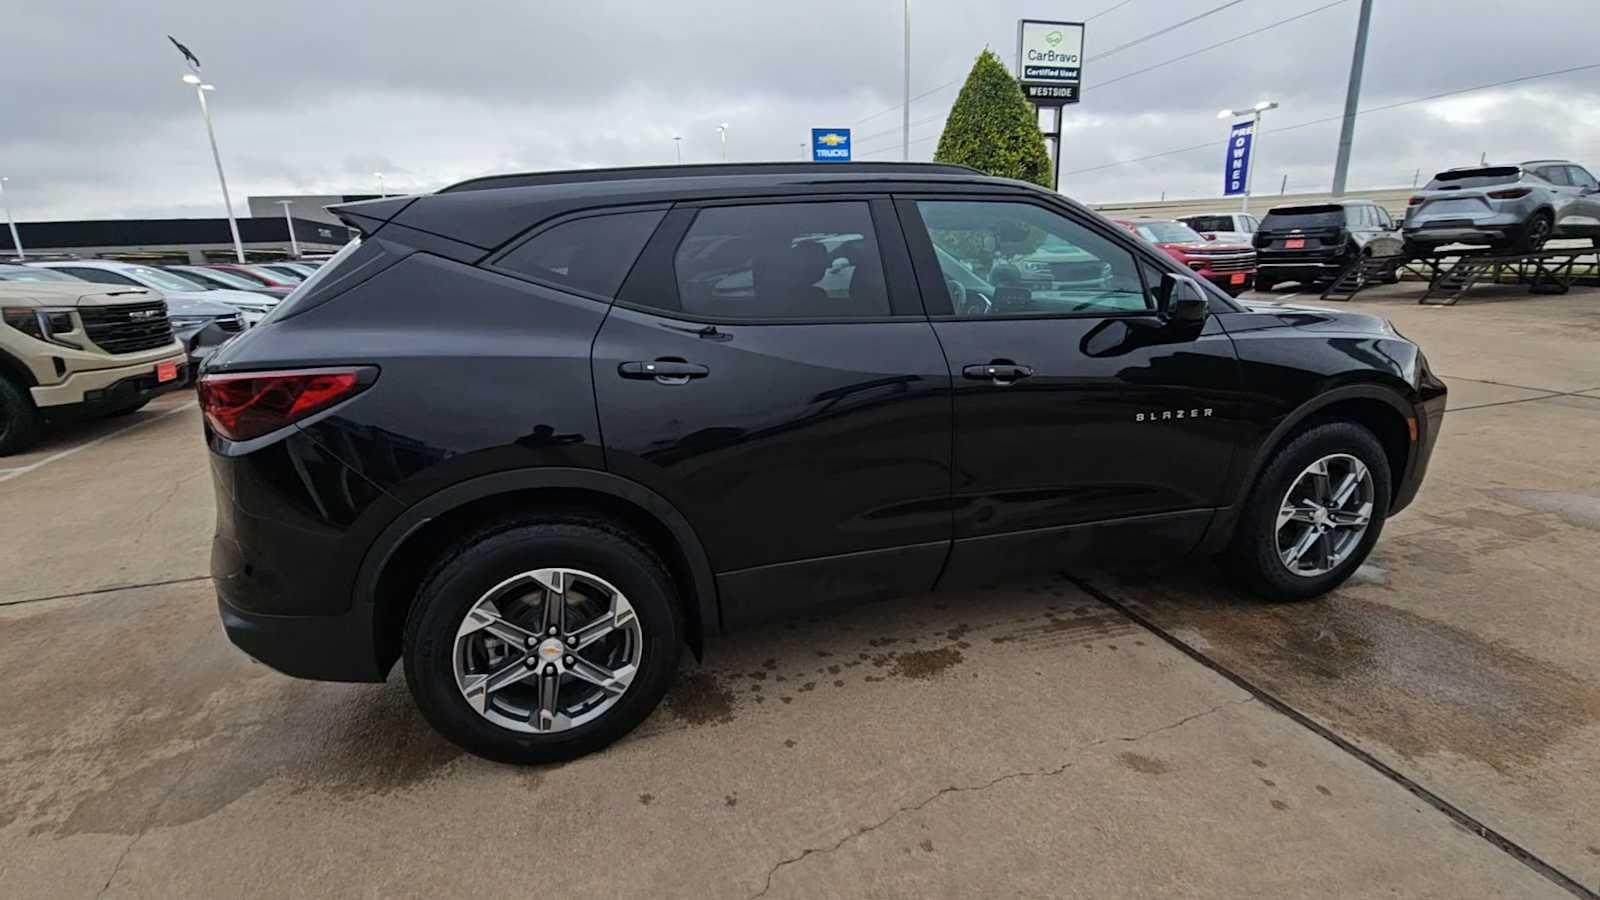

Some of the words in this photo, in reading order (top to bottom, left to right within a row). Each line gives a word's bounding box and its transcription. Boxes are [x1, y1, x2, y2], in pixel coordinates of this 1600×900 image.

[1028, 49, 1078, 63] CarBravo
[1026, 68, 1059, 77] Certified
[1060, 69, 1077, 78] Used
[1029, 87, 1072, 97] WESTSIDE
[1232, 126, 1256, 137] PRE
[816, 149, 849, 157] TRUCKS
[1231, 137, 1245, 190] OWNED
[1136, 408, 1213, 421] BLAZER
